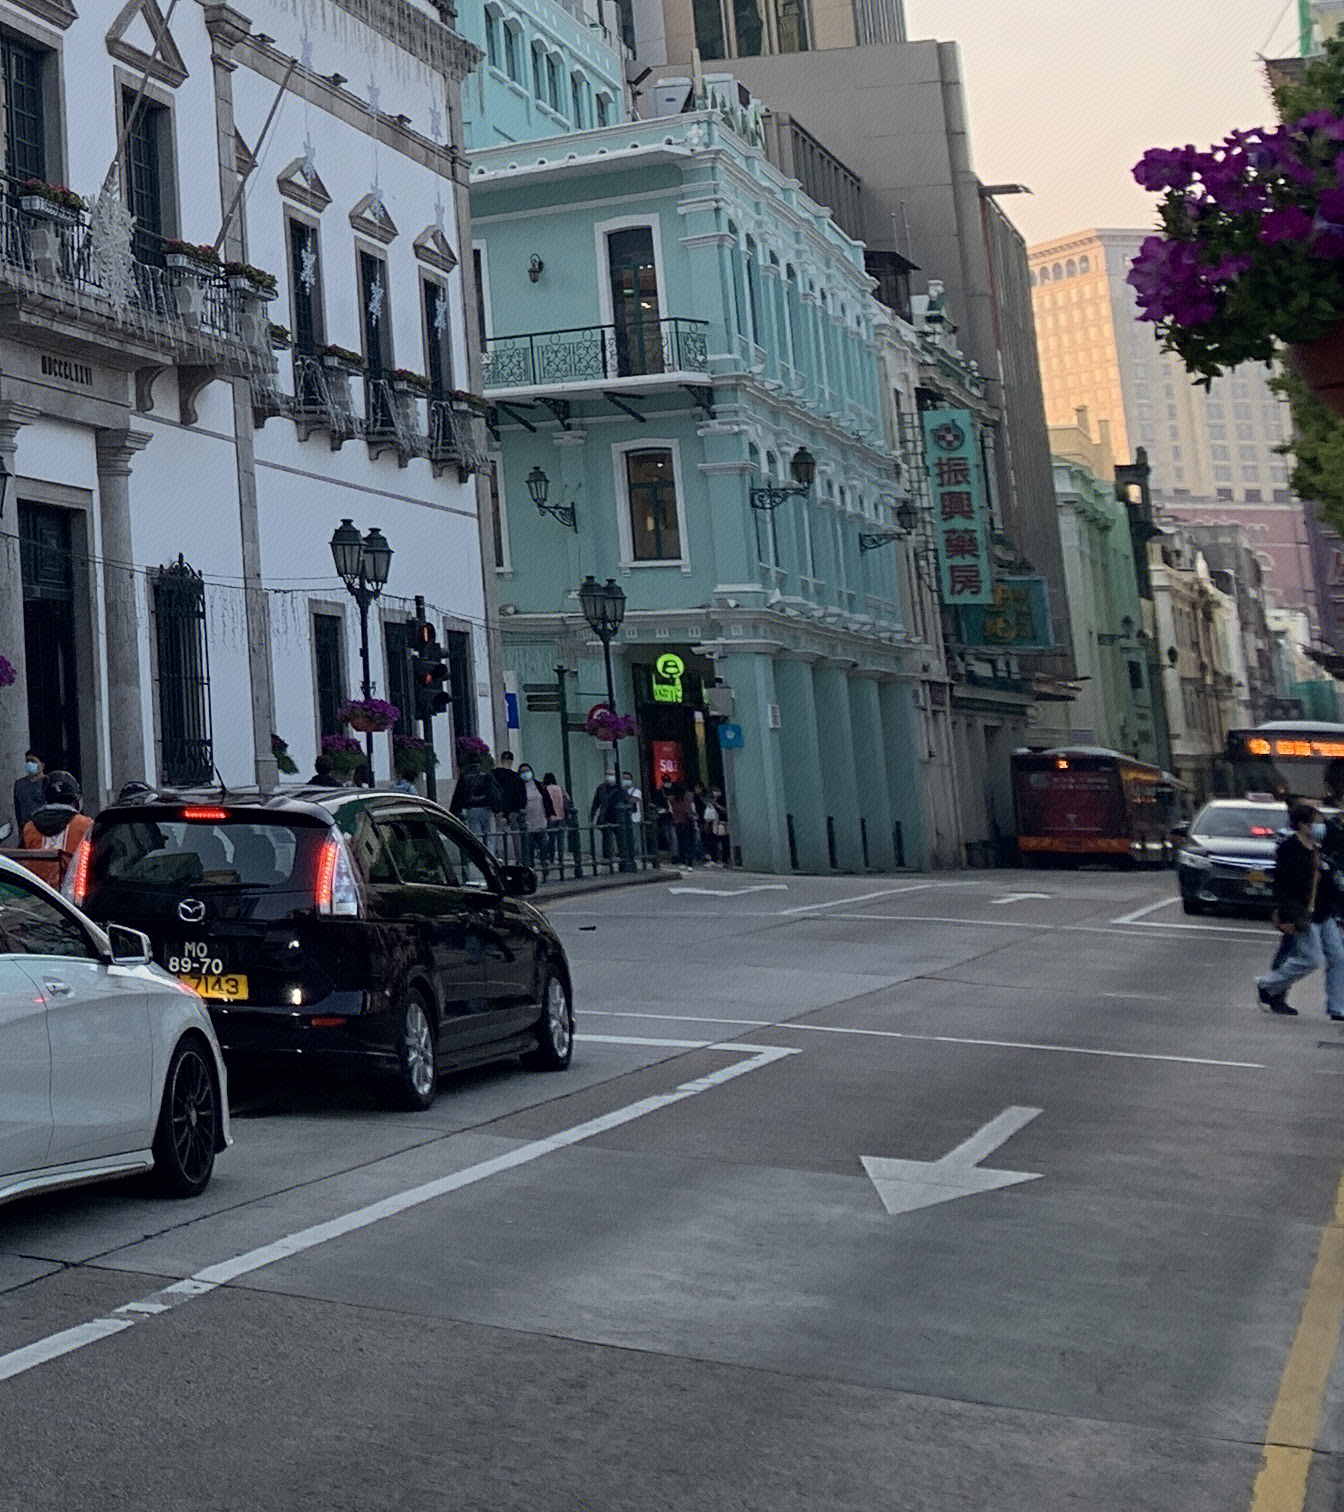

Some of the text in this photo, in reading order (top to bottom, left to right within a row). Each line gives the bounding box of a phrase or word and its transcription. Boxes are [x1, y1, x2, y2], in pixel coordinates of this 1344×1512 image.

[936, 457, 982, 595] 振興藥房
[184, 941, 208, 958] MO
[169, 956, 223, 975] 89-70
